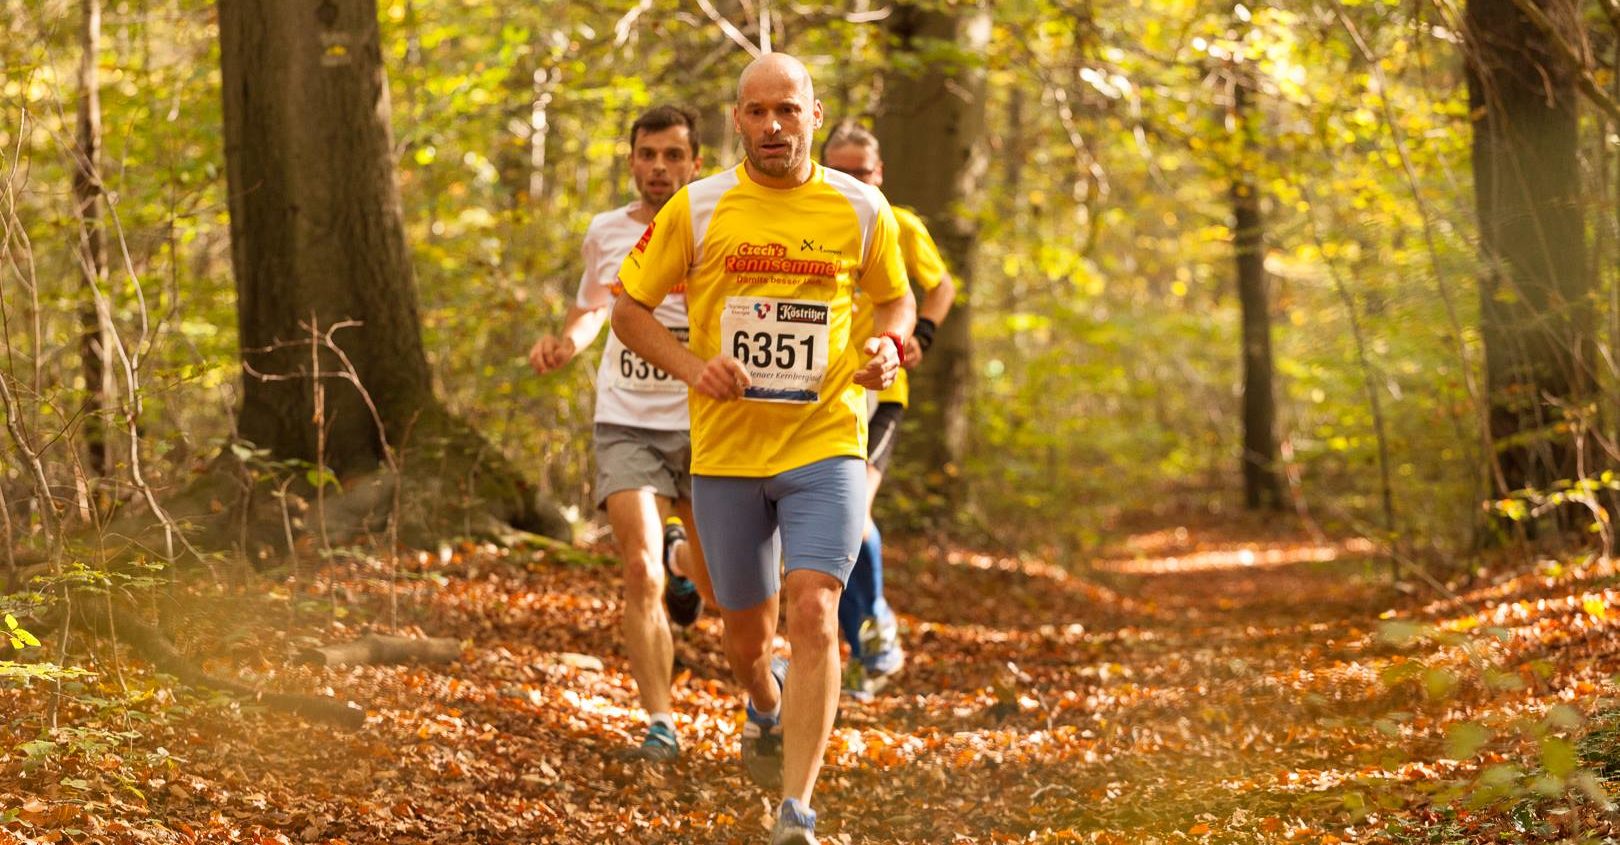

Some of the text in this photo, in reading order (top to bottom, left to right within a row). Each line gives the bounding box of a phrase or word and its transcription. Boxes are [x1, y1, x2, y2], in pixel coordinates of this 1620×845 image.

[738, 243, 785, 257] Czech's
[725, 256, 841, 277] Rennsemmel
[779, 304, 826, 322] Köstritzer
[732, 330, 815, 371] 6351
